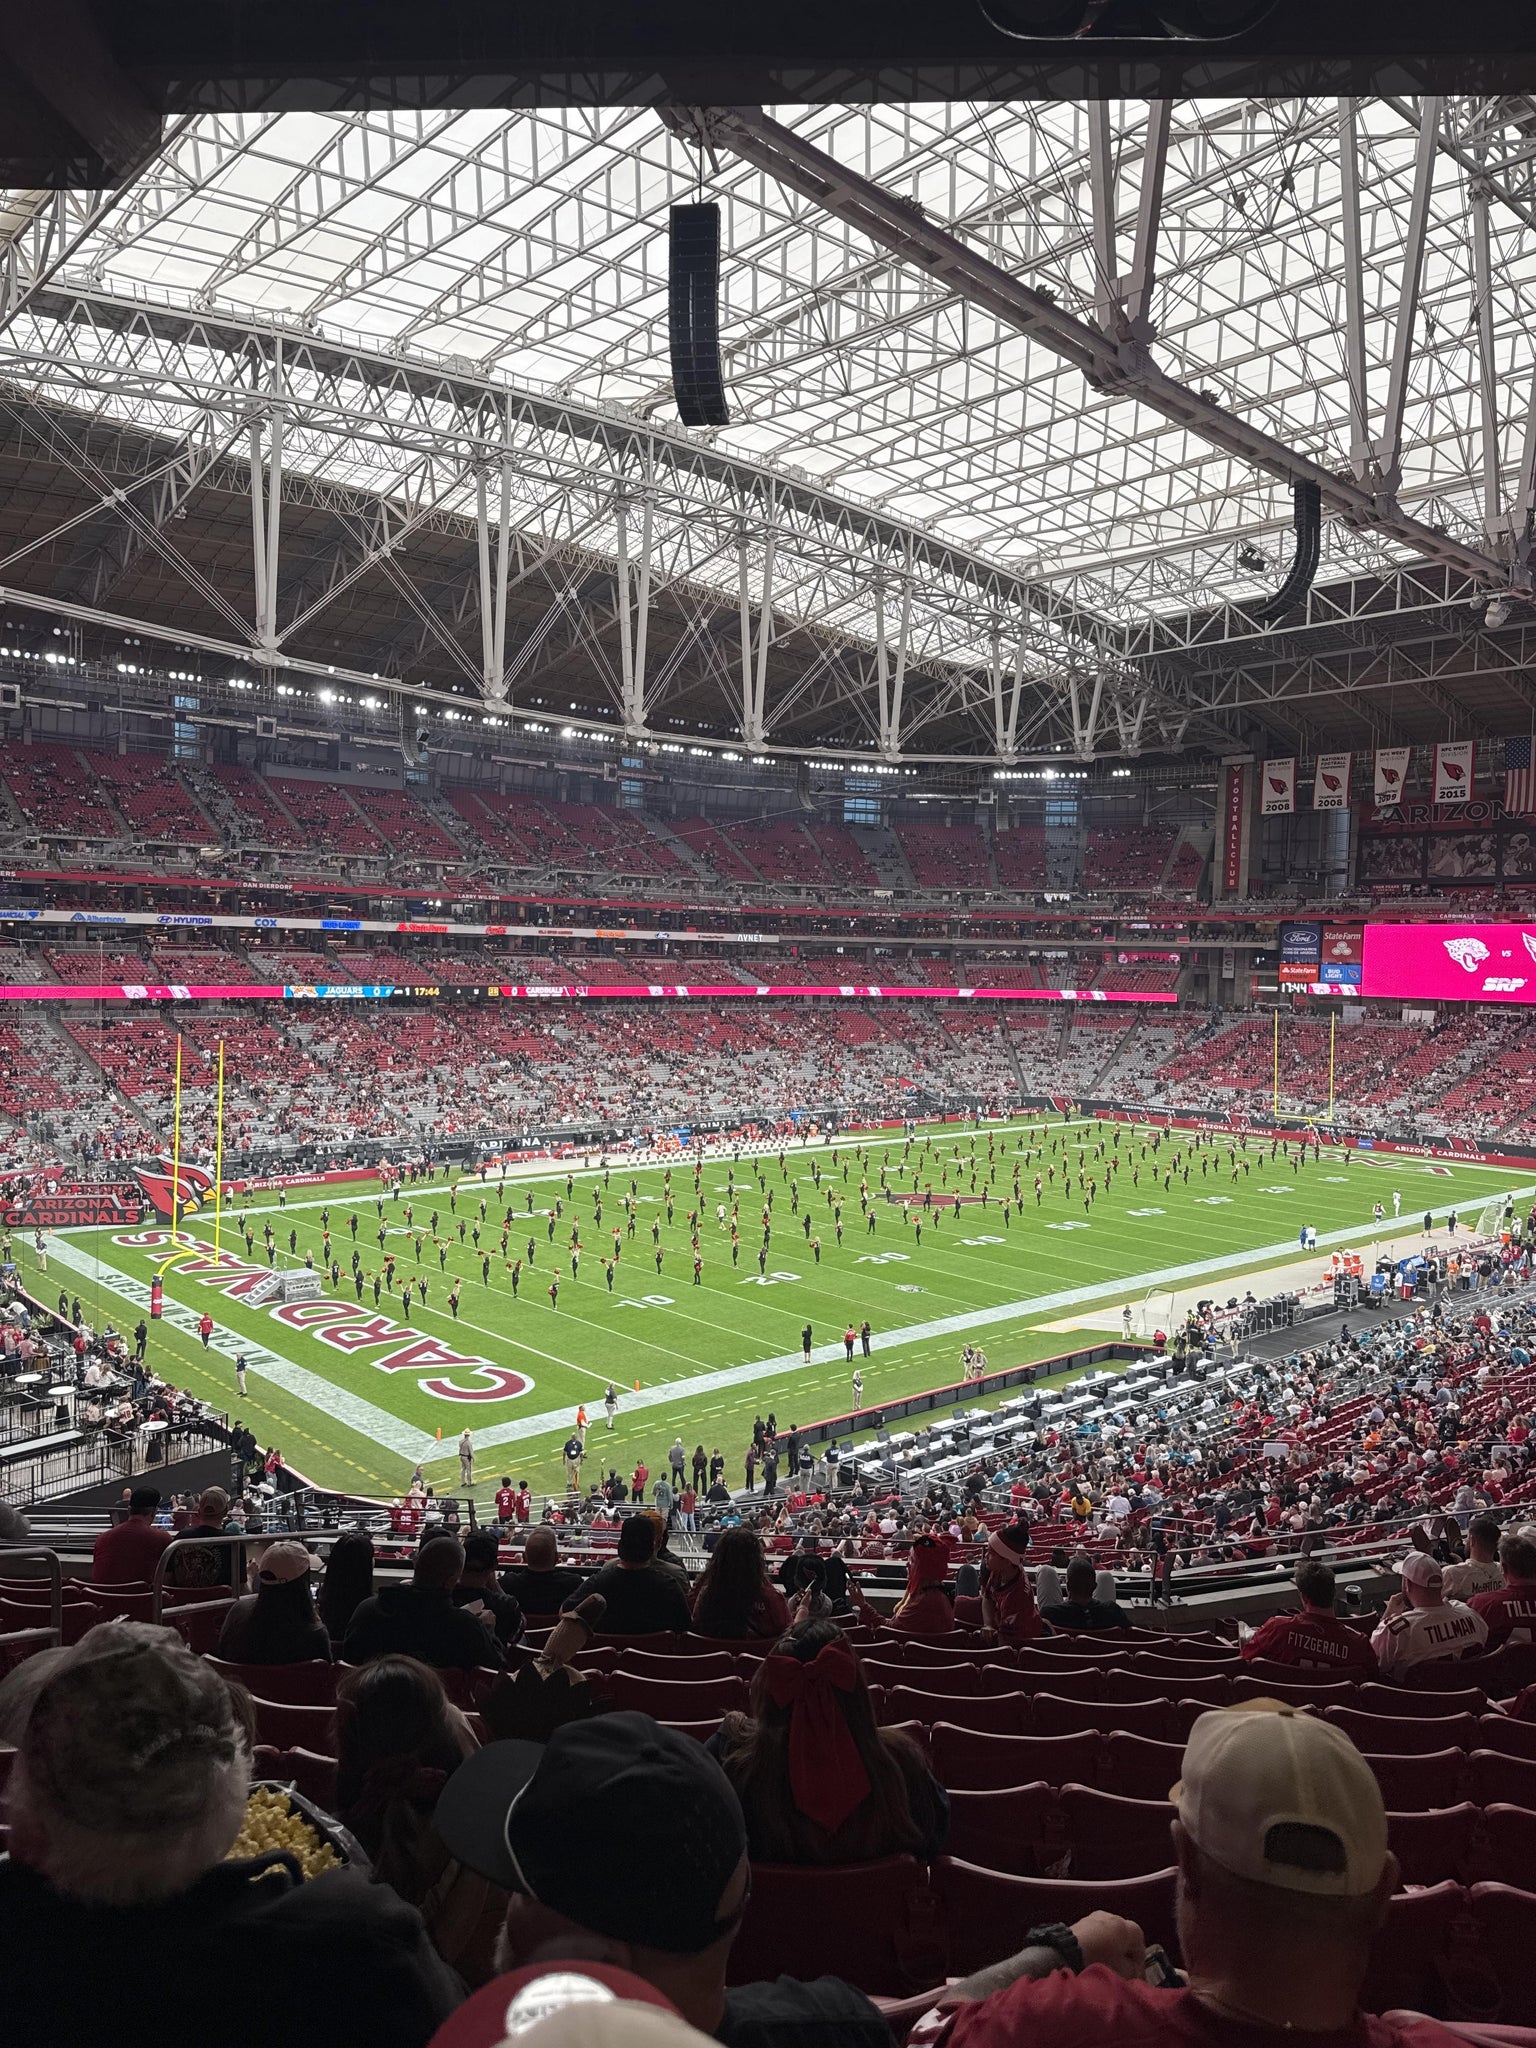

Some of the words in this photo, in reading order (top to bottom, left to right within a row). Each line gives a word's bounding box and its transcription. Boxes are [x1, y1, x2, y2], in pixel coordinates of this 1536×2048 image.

[1439, 790, 1466, 799] 2015
[1265, 803, 1290, 811] 2008
[1318, 799, 1343, 807] 2008
[1231, 778, 1239, 849] FOOTBALL
[1229, 852, 1237, 886] CLUB
[254, 918, 277, 927] COX
[1290, 932, 1311, 942] Ford
[1324, 932, 1343, 940] State
[1343, 932, 1361, 940] Farm
[1281, 982, 1307, 993] 17:44
[1482, 977, 1525, 992] SRP
[373, 987, 381, 995] 0
[414, 987, 440, 996] 17:44
[526, 987, 563, 995] CARDINALS
[1197, 1122, 1229, 1132] ARIZONA
[1437, 1150, 1486, 1161] CARDINALS
[285, 1175, 326, 1185] CARDINALS
[32, 1199, 114, 1209] ARIZONA
[5, 1210, 140, 1225] CARDINALS
[1046, 1221, 1091, 1231] 50
[964, 1235, 1006, 1247] 40
[863, 1252, 911, 1265] 30
[747, 1271, 801, 1286] 20
[617, 1294, 675, 1310] 10
[502, 1497, 509, 1506] 2
[1424, 1616, 1476, 1644] TILLMAN
[1288, 1631, 1349, 1660] FITZGERALD
